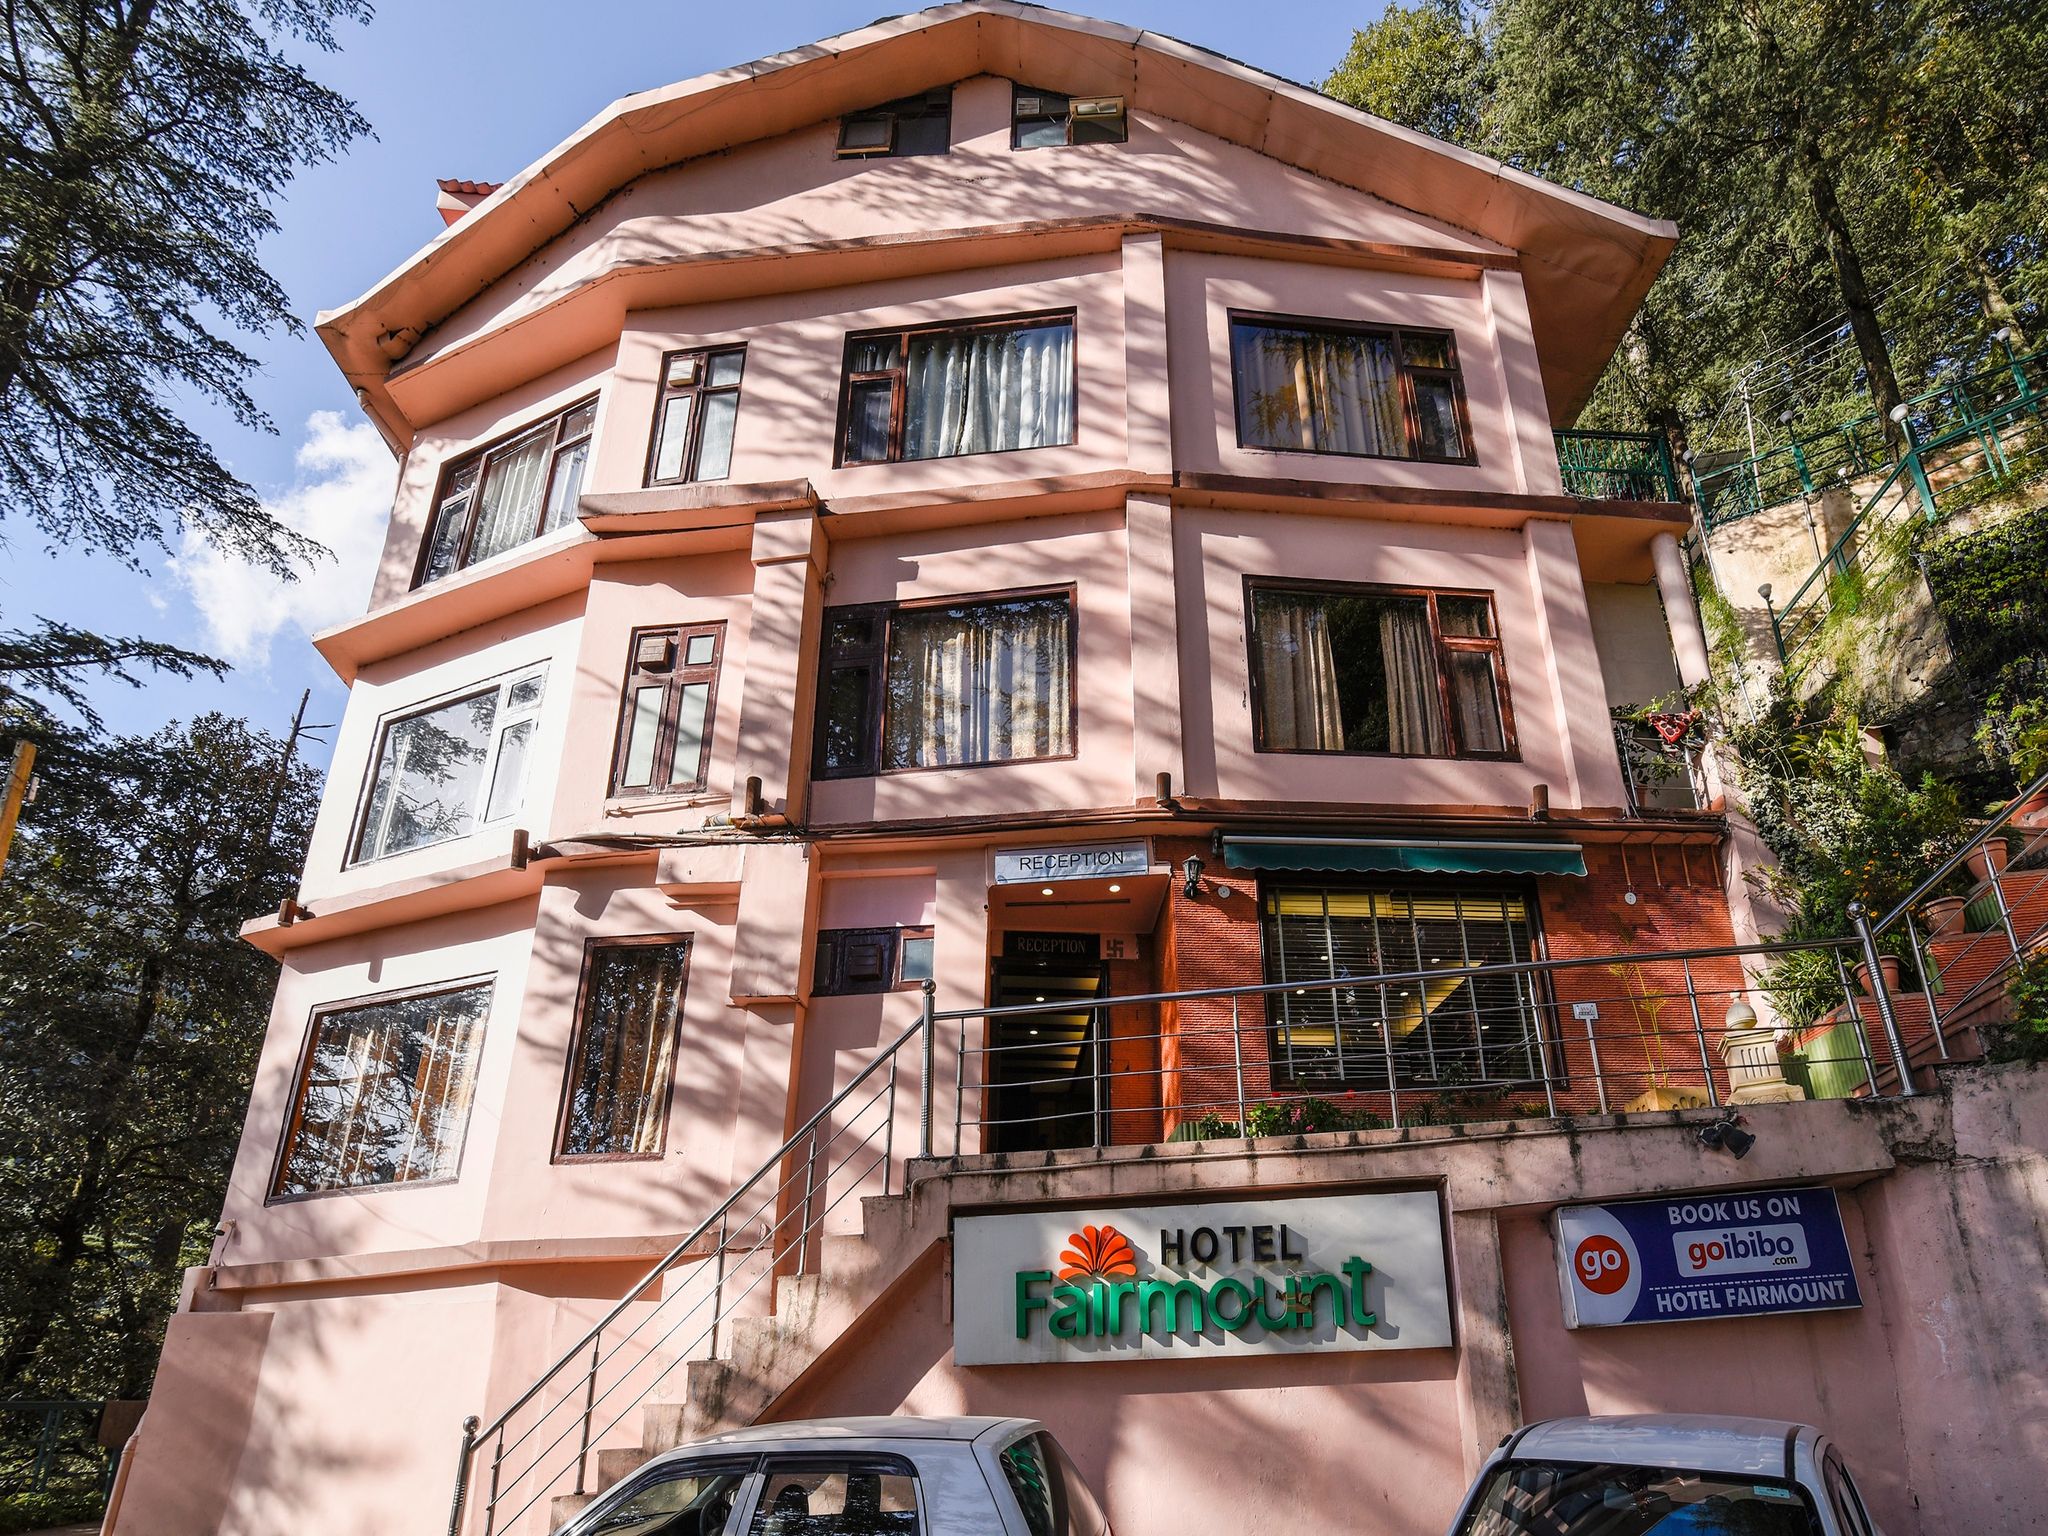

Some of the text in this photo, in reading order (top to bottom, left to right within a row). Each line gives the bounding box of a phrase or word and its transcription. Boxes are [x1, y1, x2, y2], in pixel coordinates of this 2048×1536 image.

[1020, 851, 1124, 870] RECEPTION
[1017, 936, 1087, 953] RECEPTION
[1668, 1197, 1801, 1225] BOOK US ON
[1160, 1224, 1302, 1266] HOTEL
[1688, 1231, 1794, 1269] goibibo
[1772, 1254, 1798, 1266] .com
[1581, 1248, 1621, 1280] go
[1015, 1256, 1377, 1340] Fairmount
[1657, 1280, 1846, 1313] HOTEL FAIRMOUNT
